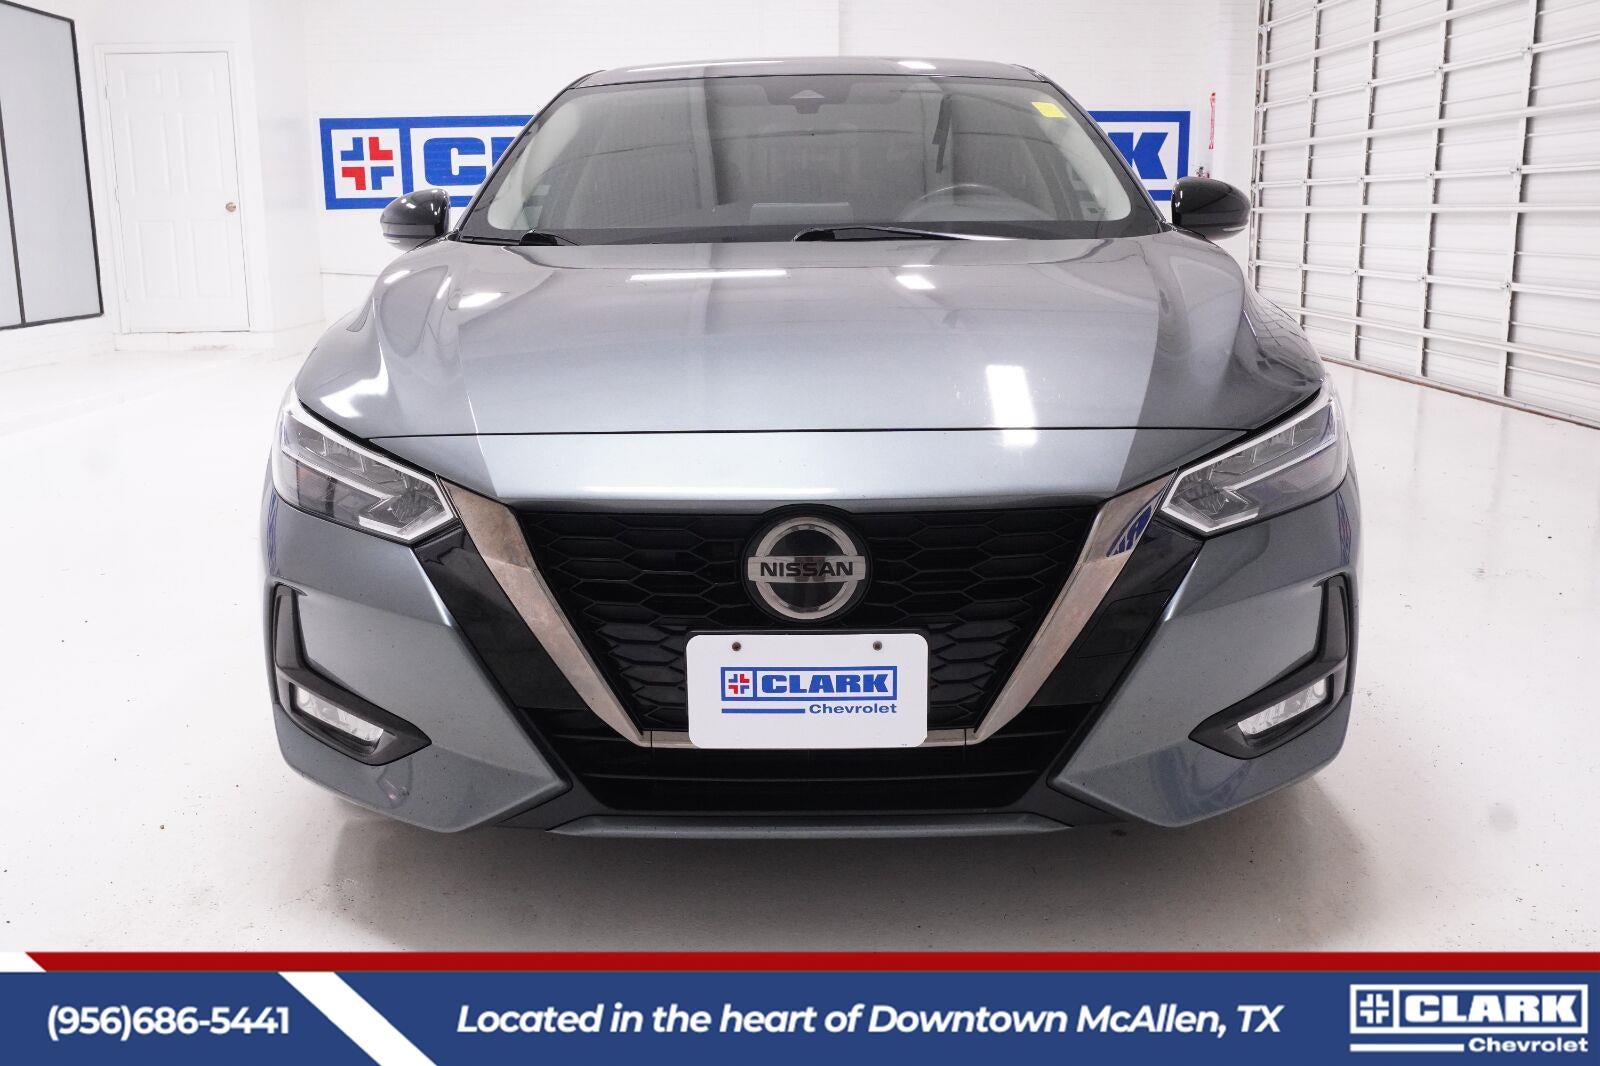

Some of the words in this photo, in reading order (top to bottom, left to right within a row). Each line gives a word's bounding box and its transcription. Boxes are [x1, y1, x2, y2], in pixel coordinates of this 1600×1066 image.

[760, 561, 854, 577] NISSAN
[761, 673, 889, 694] CLARK
[808, 703, 897, 714] Chevrolet
